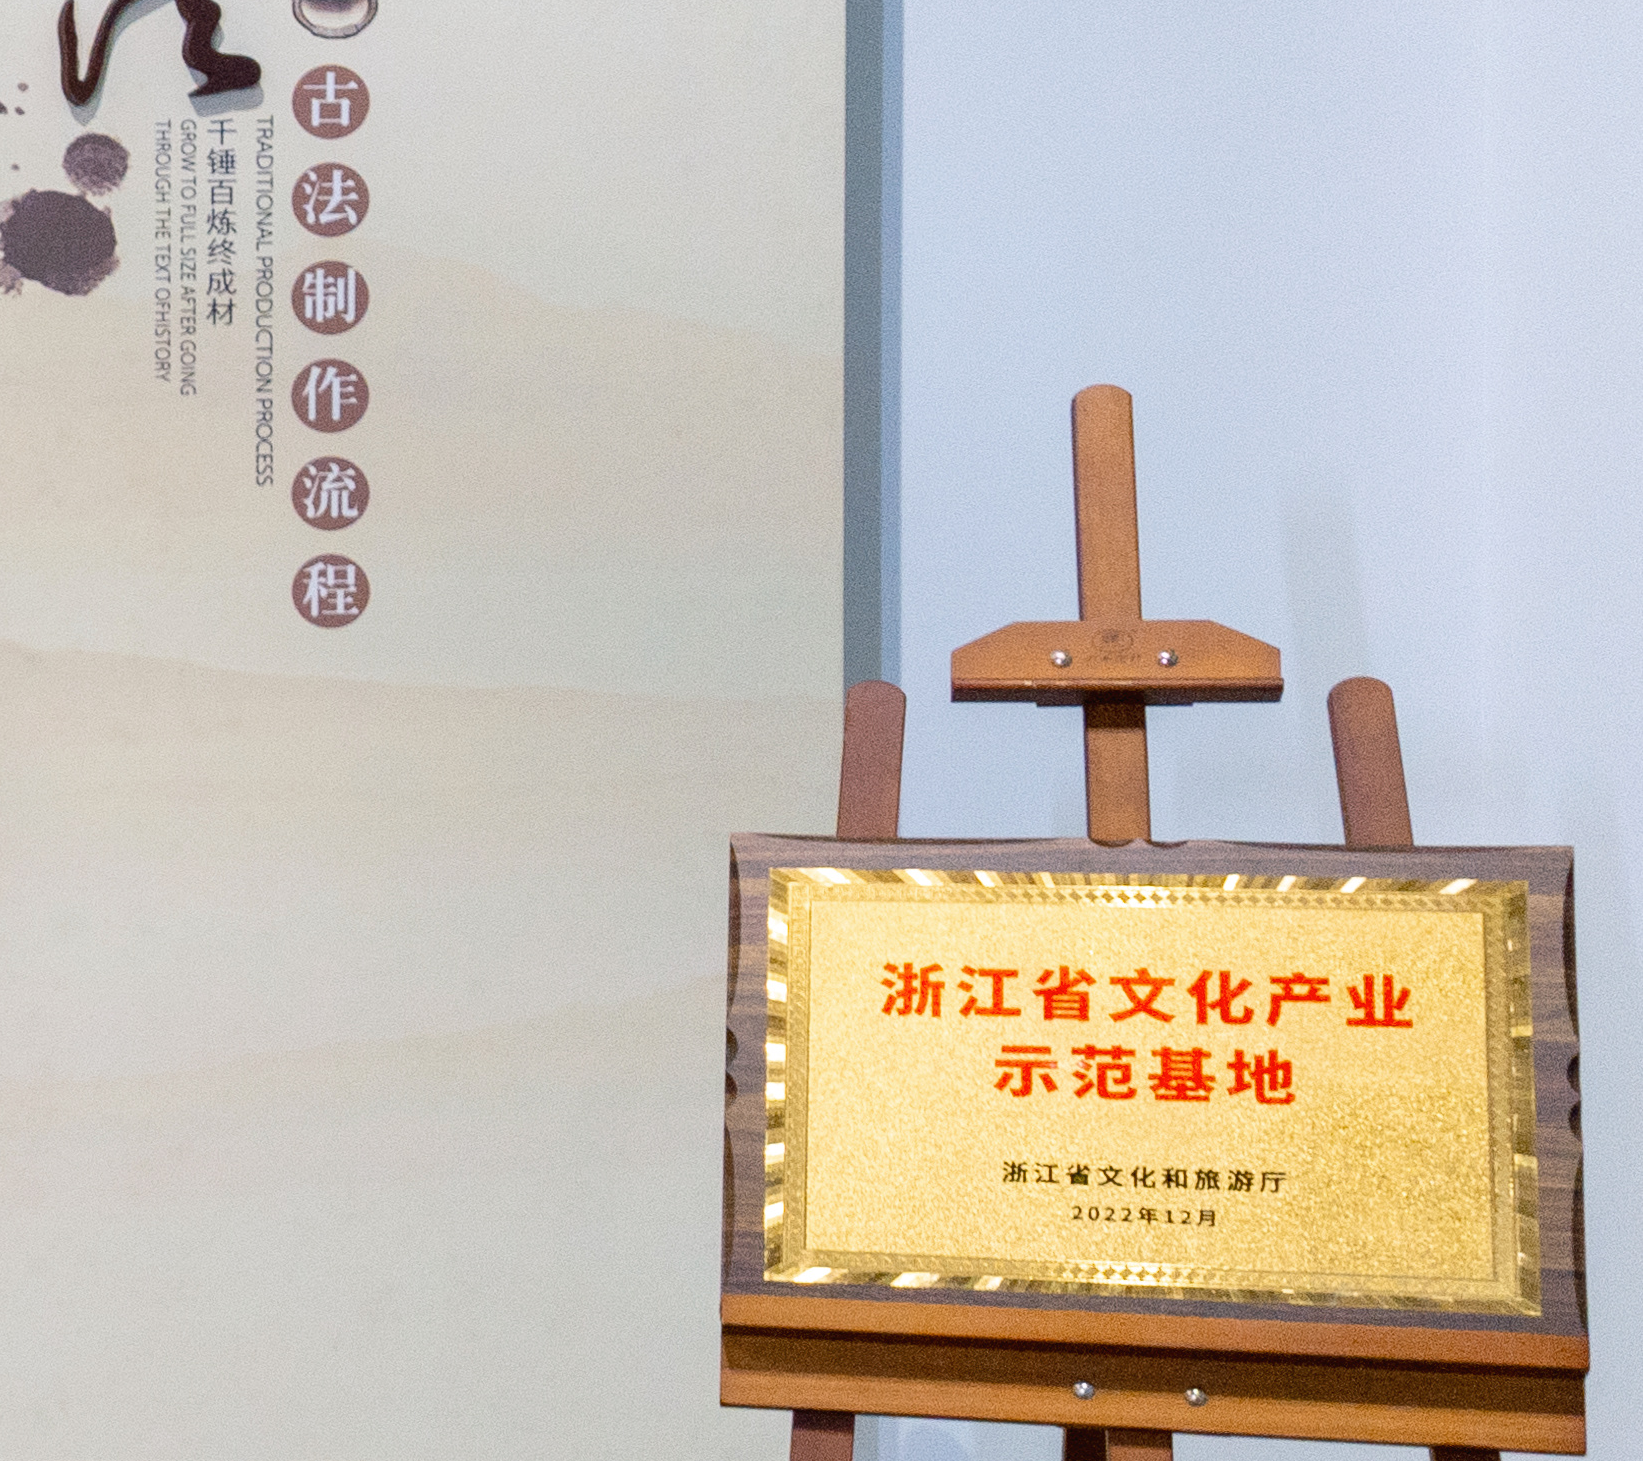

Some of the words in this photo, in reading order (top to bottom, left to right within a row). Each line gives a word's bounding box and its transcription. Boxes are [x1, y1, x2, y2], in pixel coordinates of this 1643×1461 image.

[154, 119, 172, 205] THROUGH
[180, 119, 198, 173] GROW
[180, 176, 198, 201] TO
[255, 115, 275, 252] TRADITIONAL
[154, 208, 172, 240] THE
[180, 204, 198, 244] FULL
[206, 118, 238, 327] 千锤百炼终成材
[180, 247, 198, 282] SIZE
[180, 284, 198, 337] AFTER
[255, 256, 275, 395] PRODUCTION
[180, 340, 198, 397] GOING
[296, 69, 367, 627] 古法制作流程
[255, 398, 275, 487] PROCESS
[882, 963, 1414, 1030] 浙江省文化产业
[995, 1045, 1296, 1106] 示范基地
[1003, 1161, 1287, 1193] 浙江省文化和旅游厅
[1071, 1206, 1217, 1228] 2022年12月
